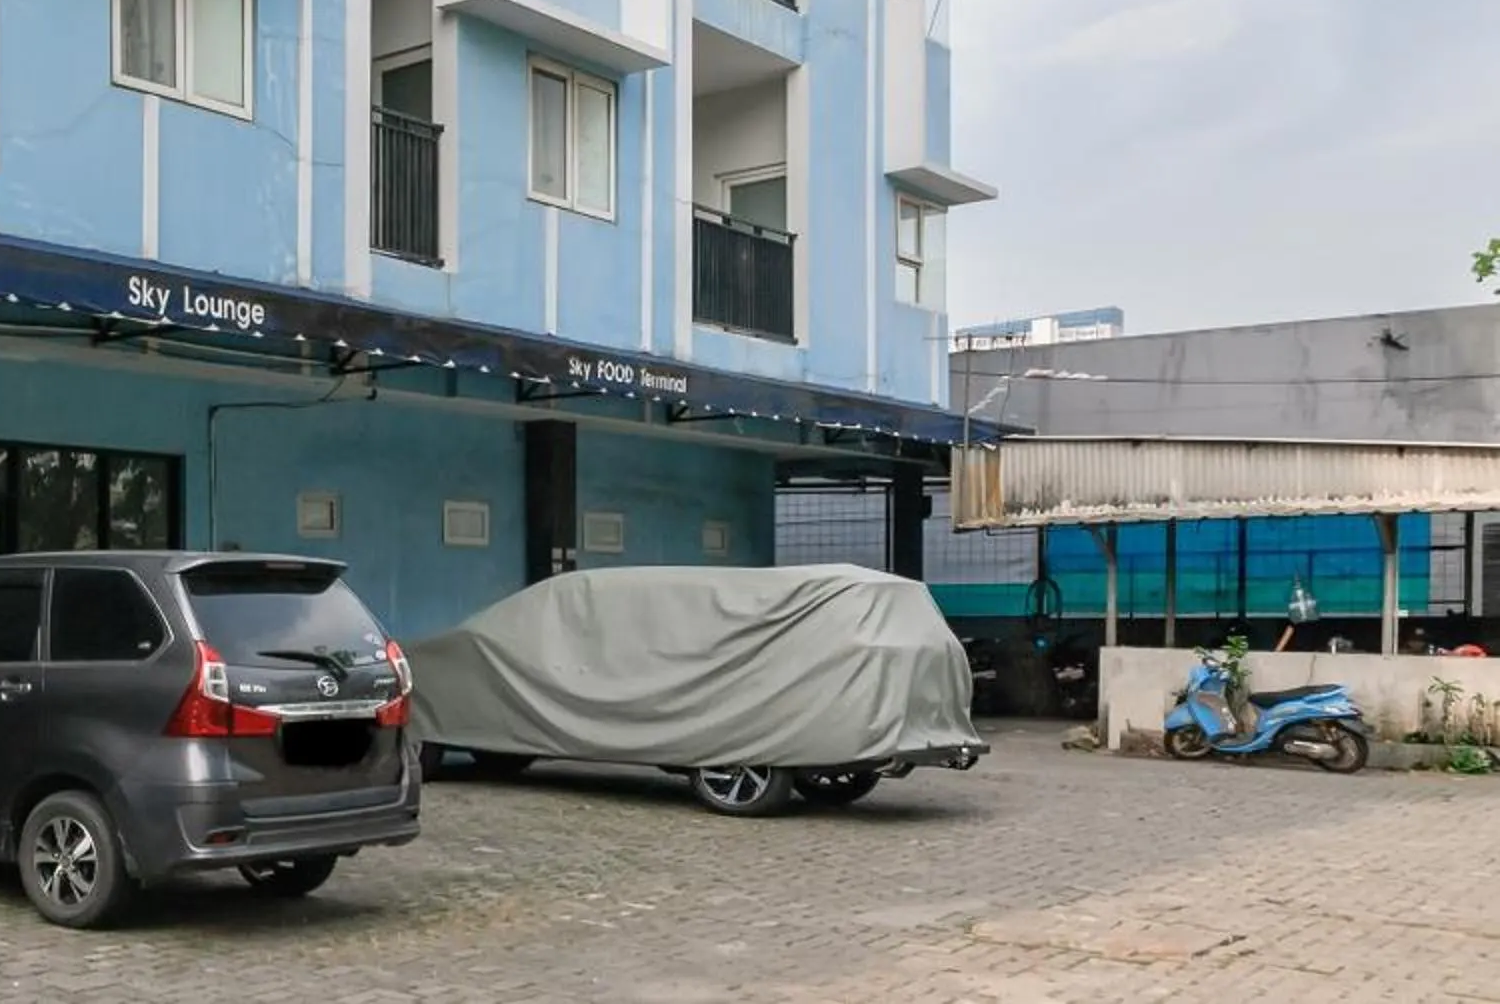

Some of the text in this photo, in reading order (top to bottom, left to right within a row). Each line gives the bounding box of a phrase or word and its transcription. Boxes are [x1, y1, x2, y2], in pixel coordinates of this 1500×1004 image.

[128, 275, 266, 330] Sky Lounge
[568, 356, 687, 394] Sky FOOD Terminal
